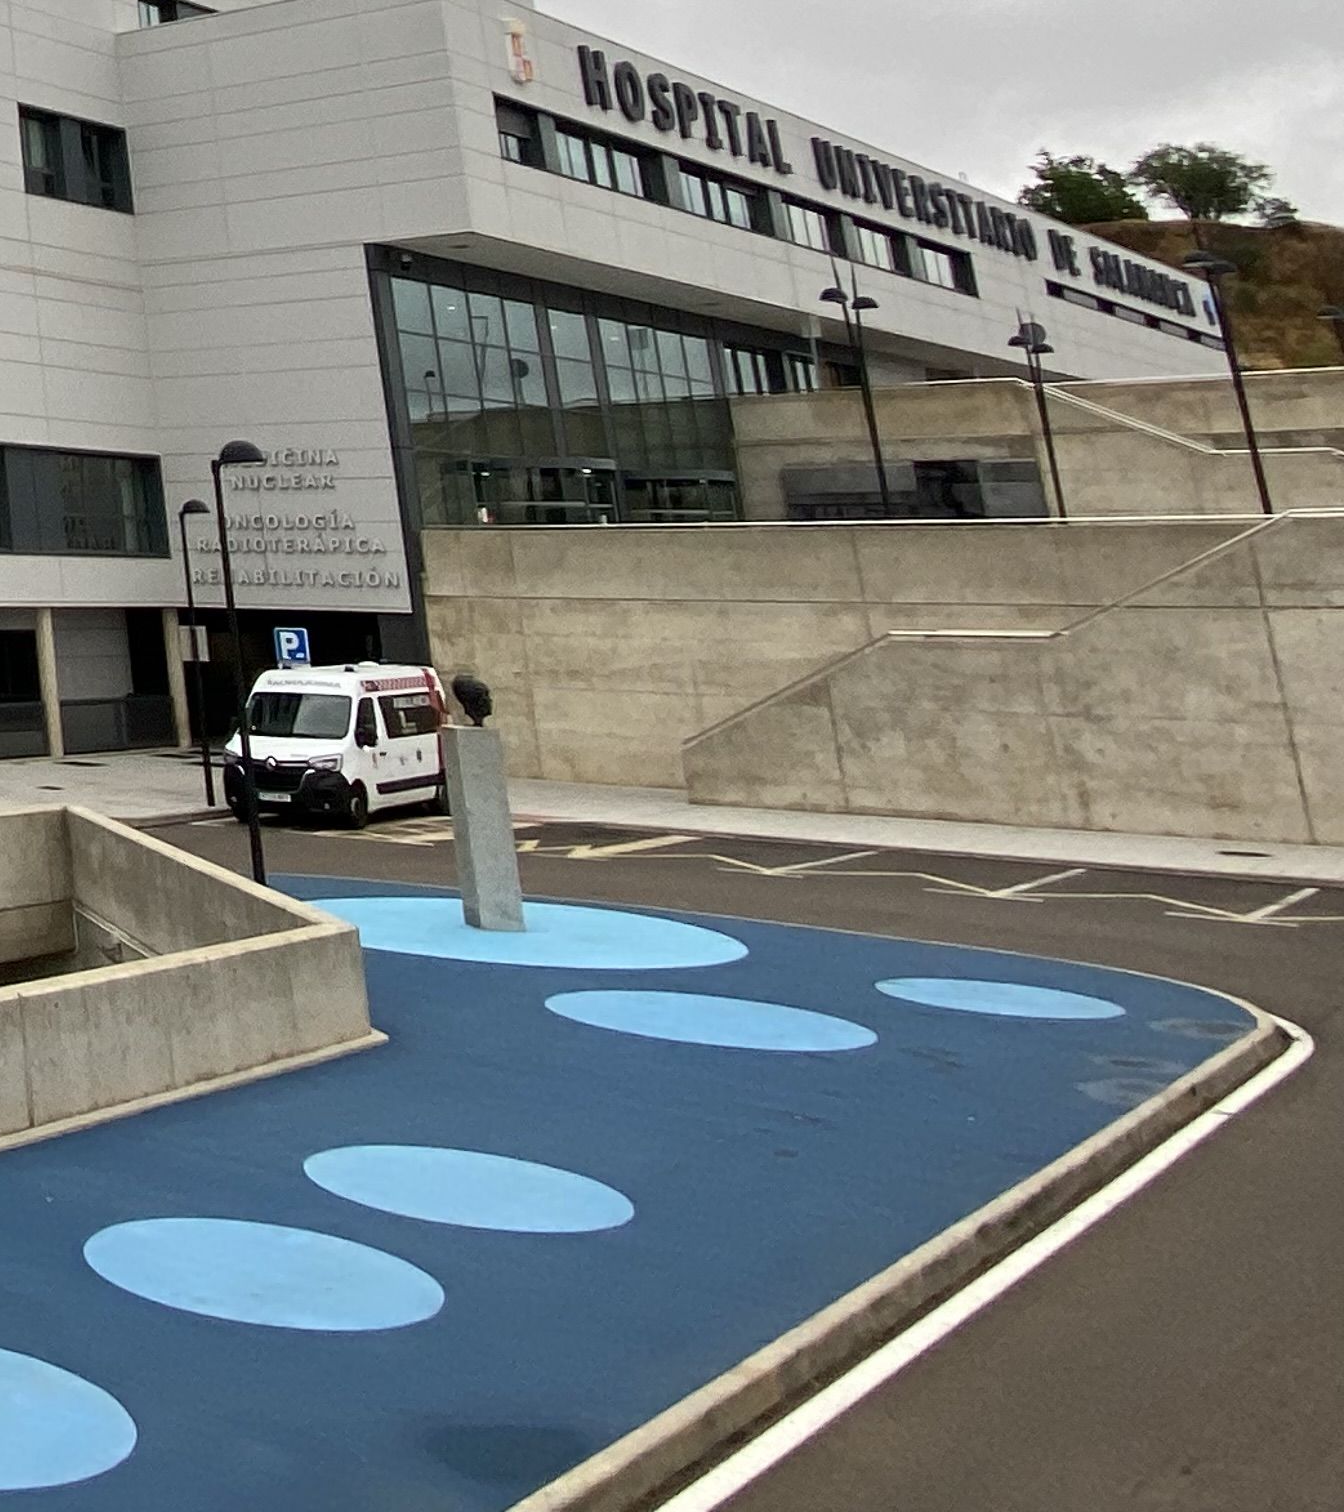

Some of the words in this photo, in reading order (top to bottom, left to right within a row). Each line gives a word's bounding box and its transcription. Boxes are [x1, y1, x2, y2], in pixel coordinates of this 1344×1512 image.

[577, 44, 793, 175] HOSPITAL
[810, 137, 1038, 261] UNIVERSITARIO
[1047, 229, 1081, 277] DE
[230, 473, 335, 491] NUCLEAR
[195, 533, 387, 553] RADIOTERÁPICA
[192, 567, 401, 587] REABILITACIÓN
[279, 631, 300, 660] P
